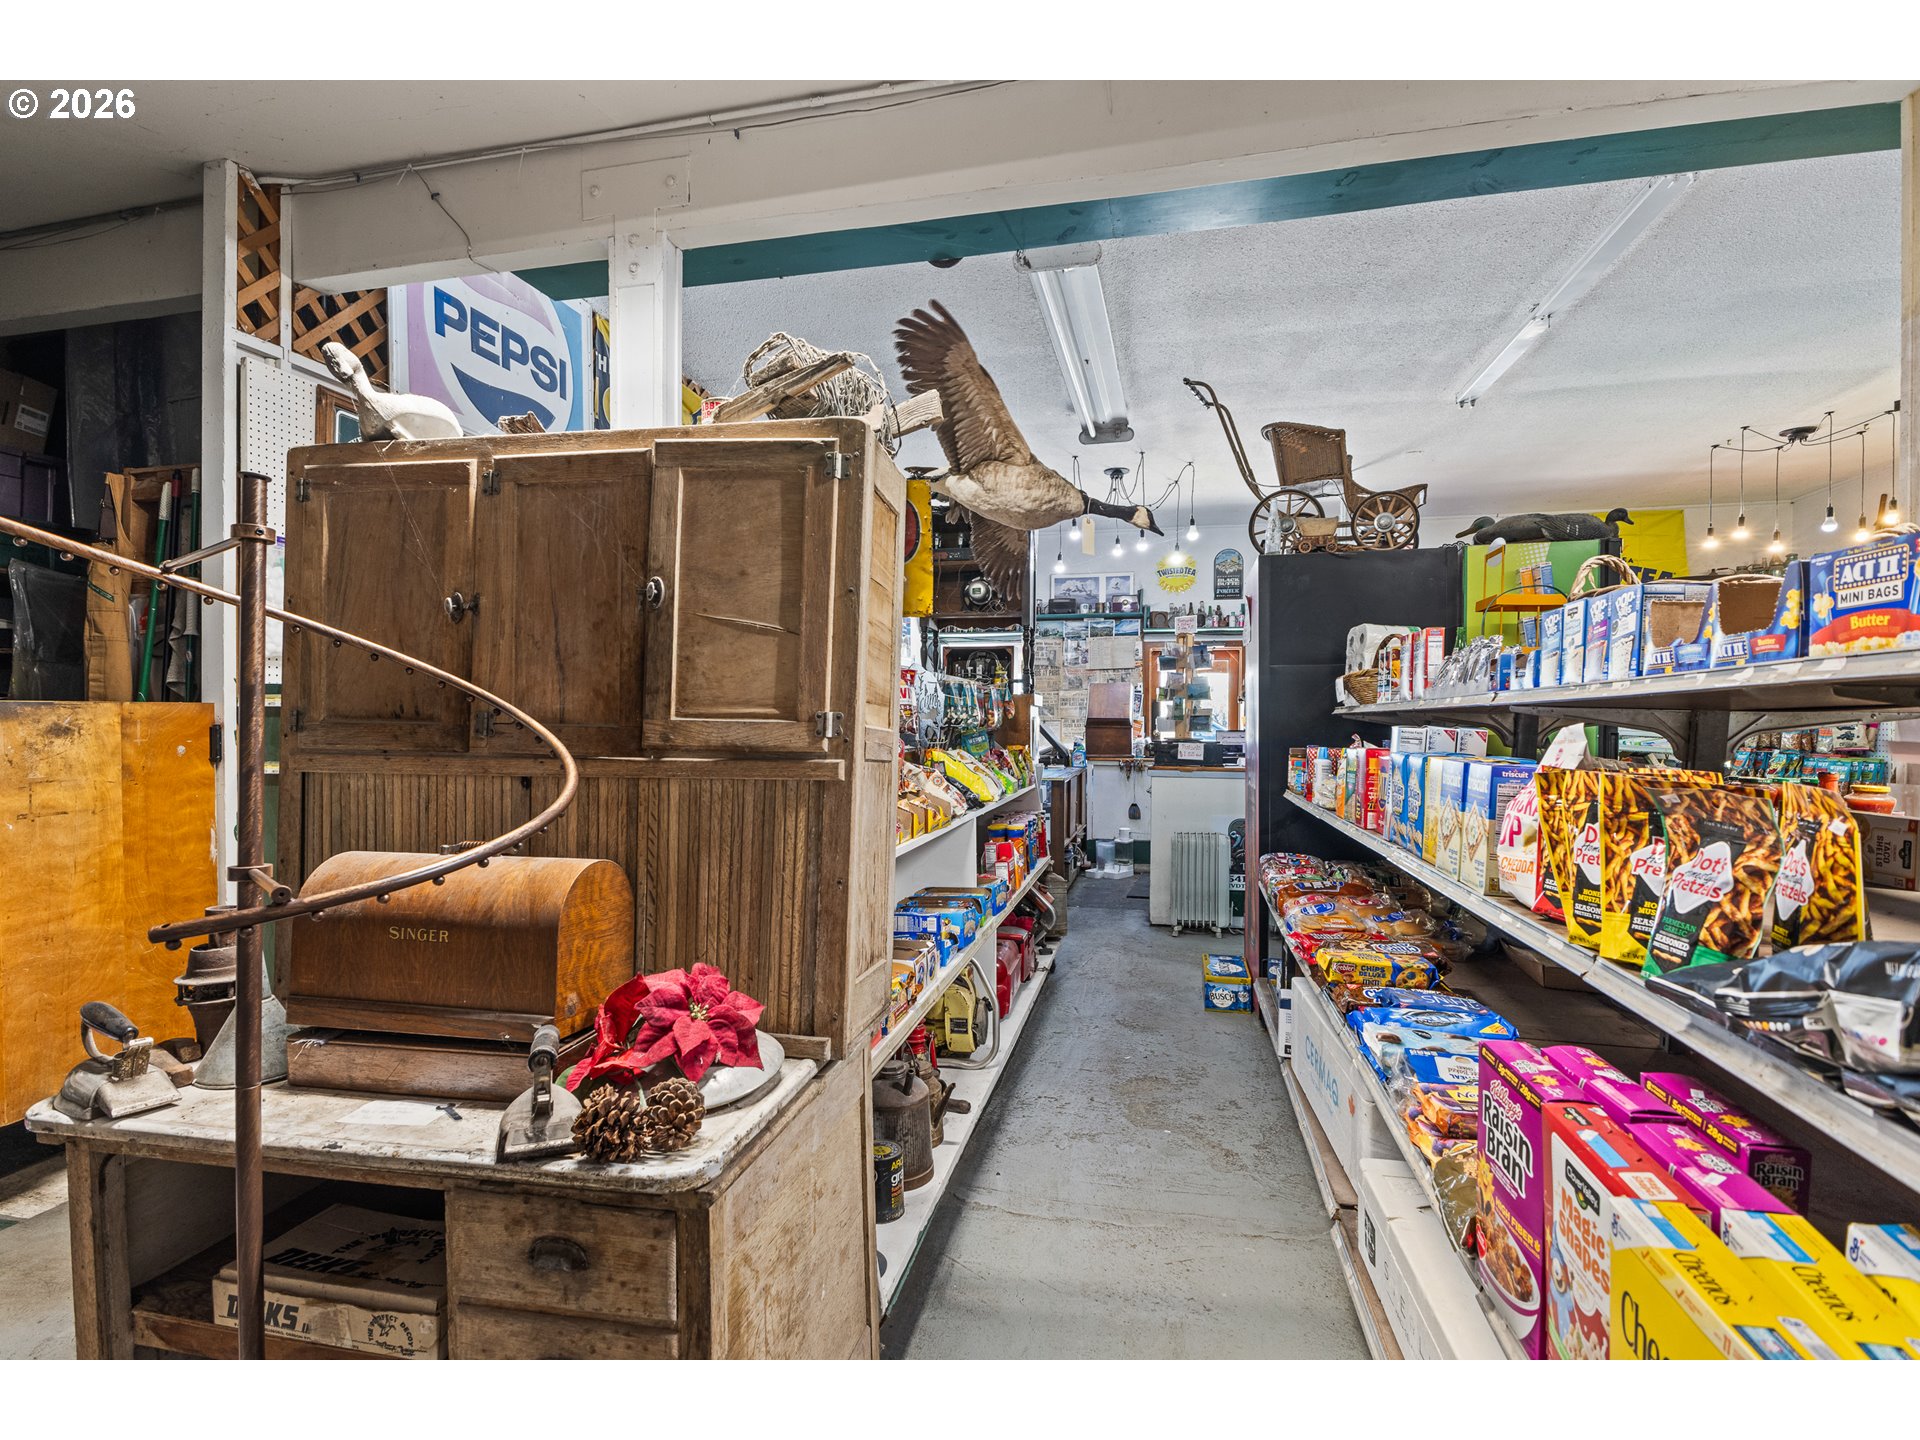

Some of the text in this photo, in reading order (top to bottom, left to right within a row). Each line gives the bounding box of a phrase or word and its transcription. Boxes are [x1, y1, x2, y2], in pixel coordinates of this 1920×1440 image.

[433, 287, 568, 400] PEPSI
[1157, 565, 1197, 577] TWISTED TEA
[1840, 559, 1876, 585] ACT
[1877, 554, 1900, 577] II
[1840, 584, 1899, 605] MINI BAGS
[1849, 613, 1891, 630] Butter
[1757, 637, 1776, 645] Butter
[1502, 769, 1529, 778] triscuit
[1691, 849, 1728, 876] Dot's
[1875, 834, 1884, 868] SHELLS
[1882, 841, 1892, 864] TACO
[1673, 873, 1723, 900] Pretzels
[388, 925, 450, 944] SINGER
[1654, 932, 1691, 951] SEASONED
[1333, 963, 1356, 971] Keebler
[1209, 991, 1236, 1002] BUSCH
[1484, 1092, 1533, 1177] Raisin
[1706, 1124, 1724, 1144] 28g
[1487, 1126, 1525, 1197] Bran
[1755, 1162, 1803, 1180] Raisin
[1760, 1174, 1798, 1189] Bran
[1511, 1219, 1534, 1248] FIBER
[1561, 1187, 1605, 1260] Magic
[1673, 1252, 1734, 1305] Cheerios
[1791, 1265, 1855, 1322] Cheerios
[399, 1321, 415, 1348] DECOY
